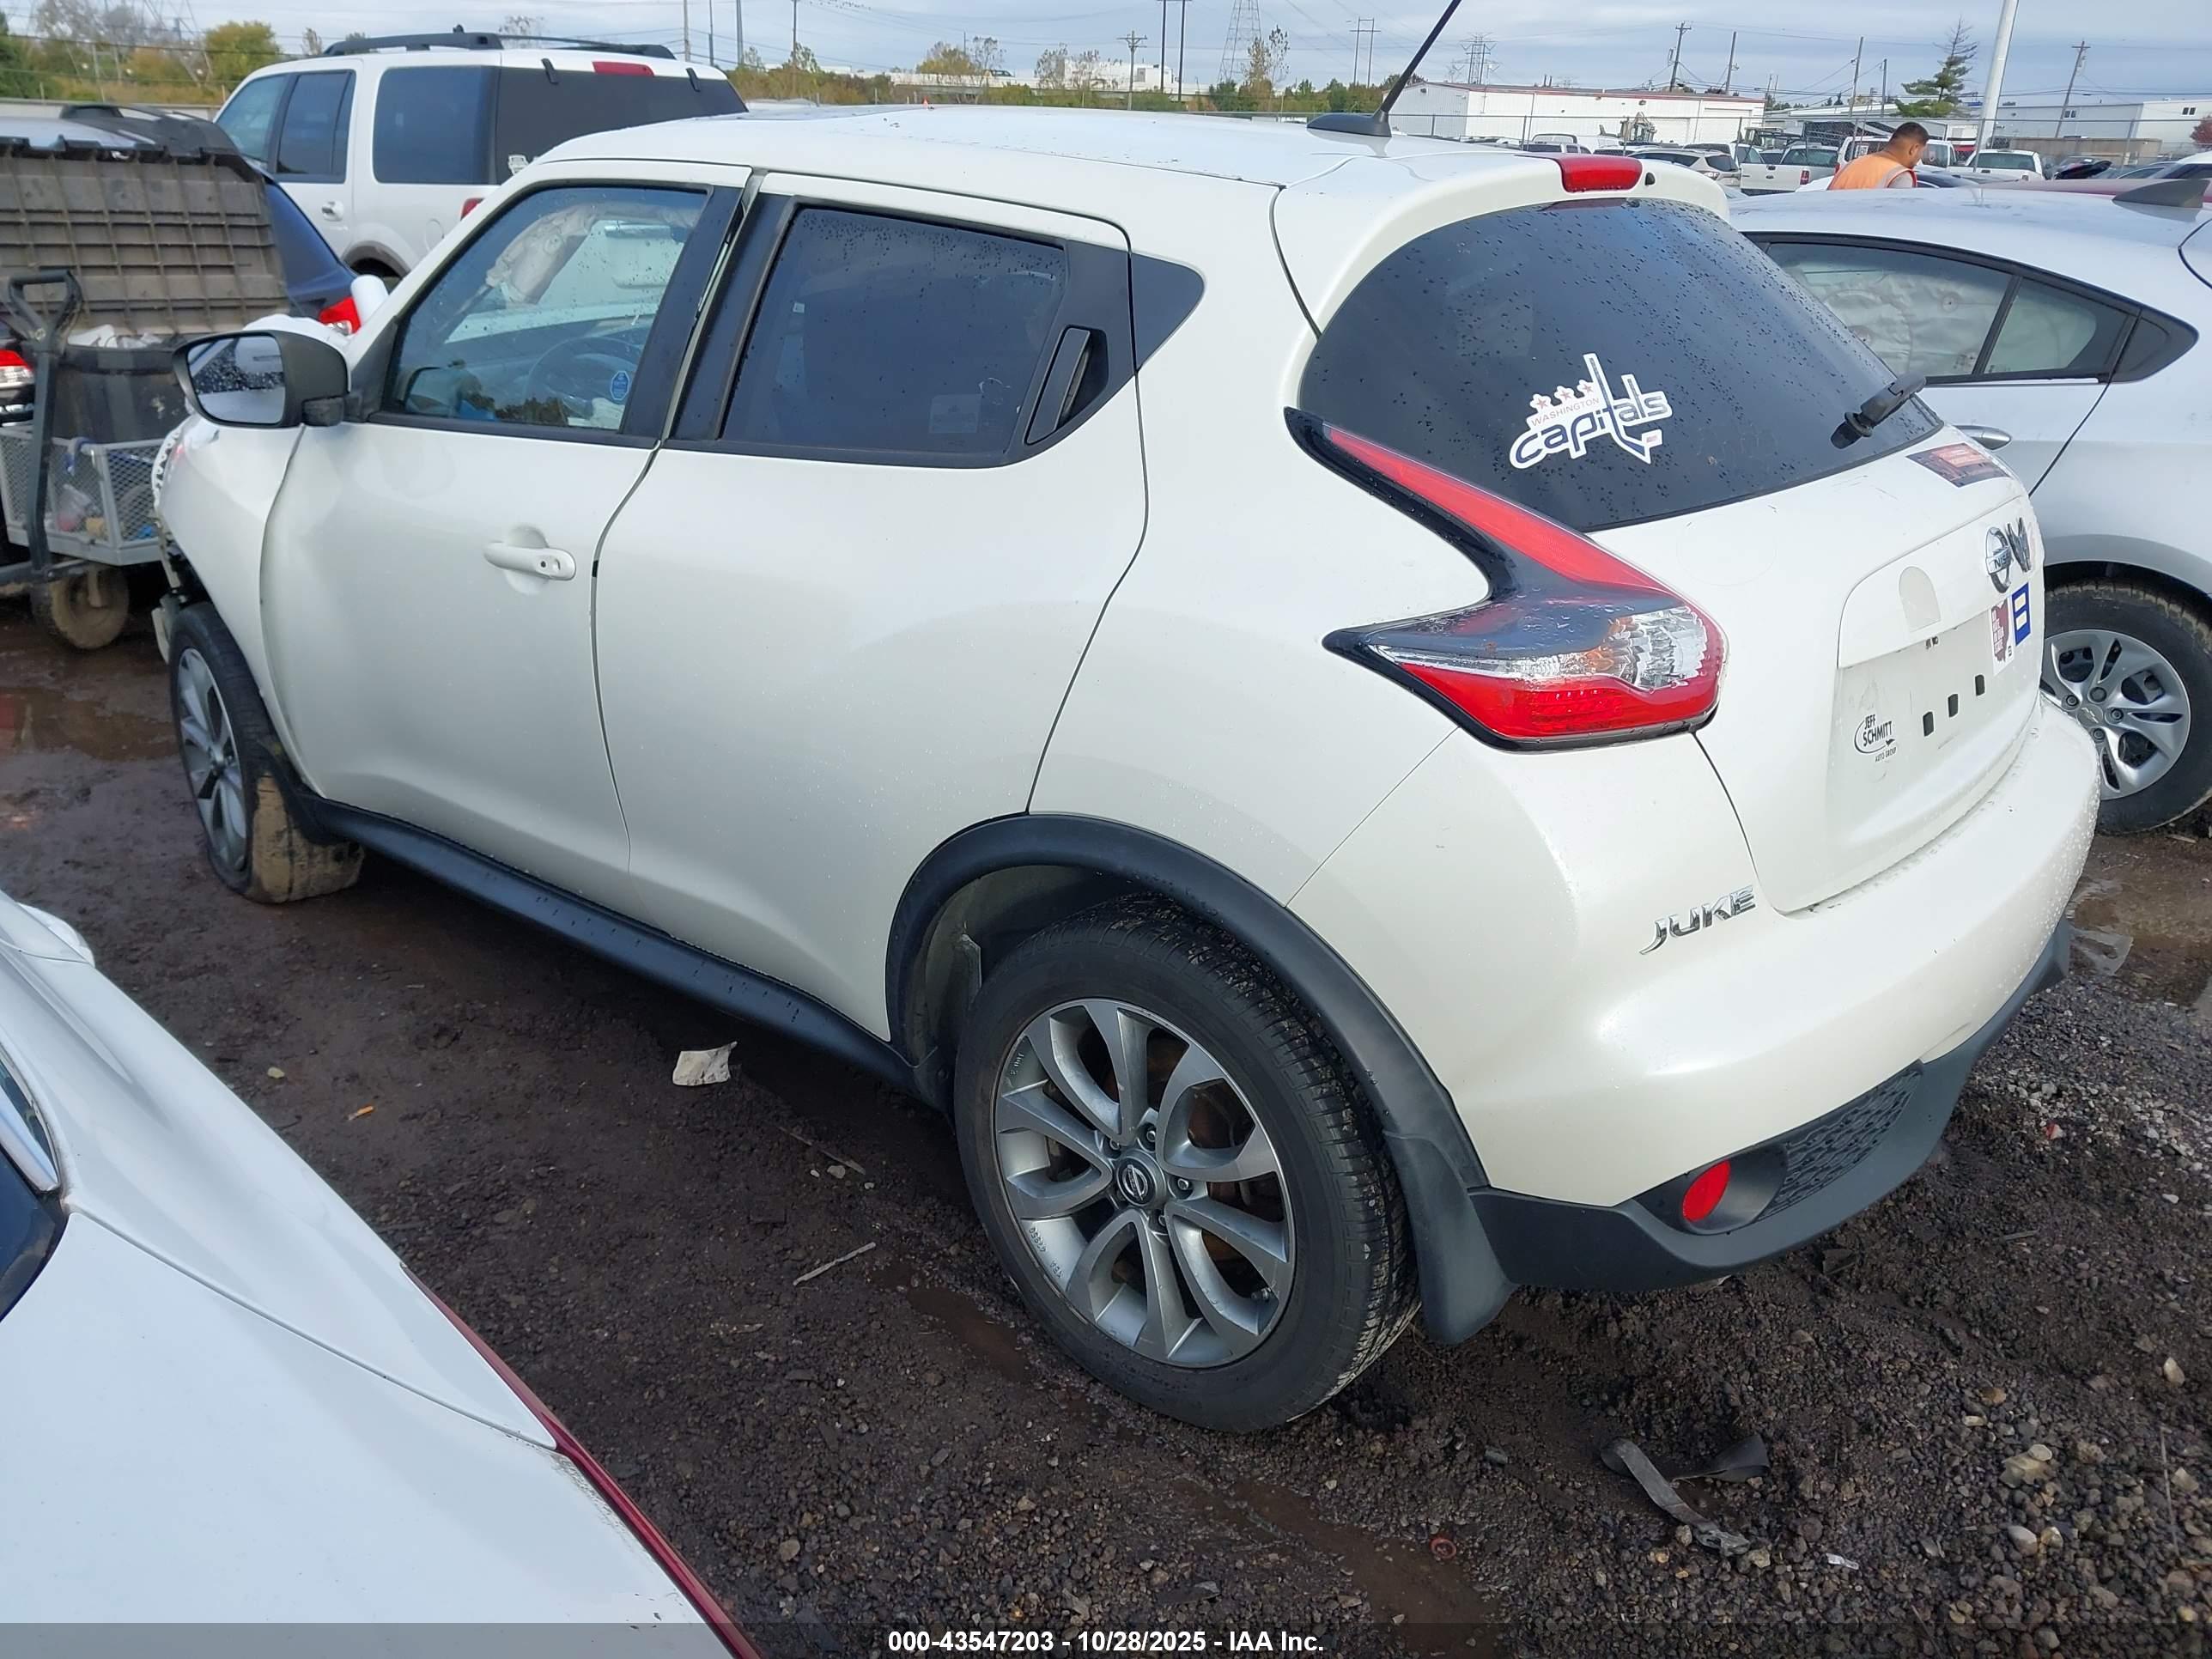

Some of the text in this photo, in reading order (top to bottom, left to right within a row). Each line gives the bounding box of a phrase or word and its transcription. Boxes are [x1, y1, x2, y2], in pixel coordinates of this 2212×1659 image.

[1531, 398, 1600, 427] WASHINGTON
[1863, 720, 1893, 747] SCHMITT
[1864, 714, 1876, 730] JEFF
[1638, 884, 1756, 956] JUKE
